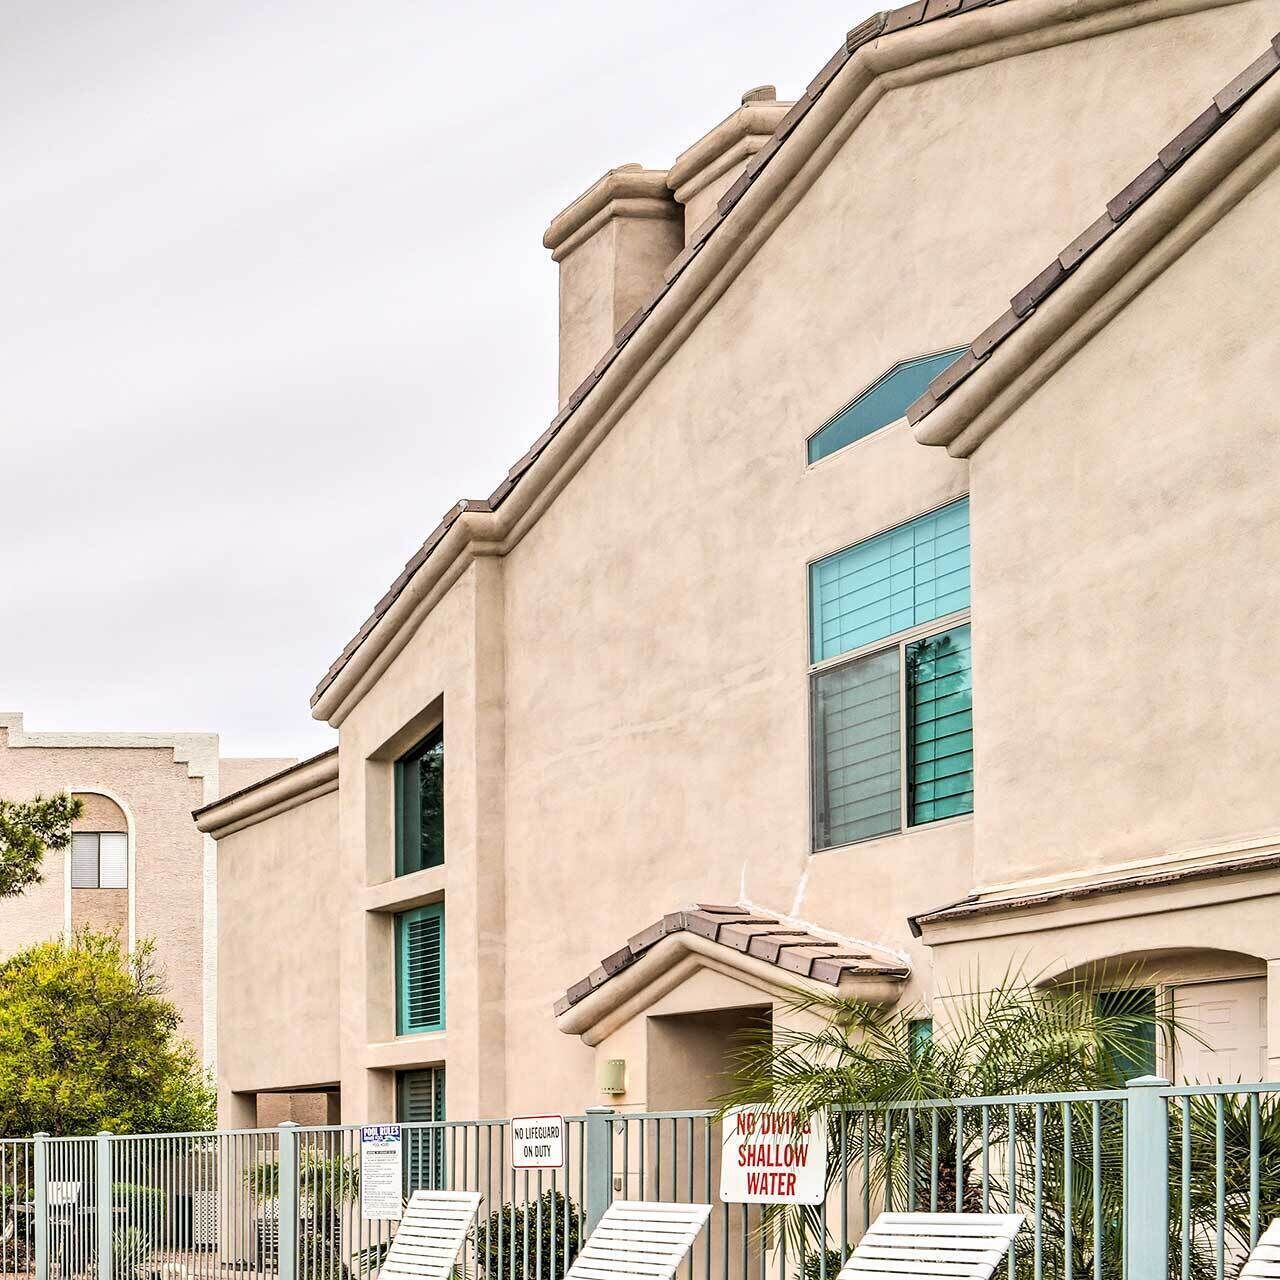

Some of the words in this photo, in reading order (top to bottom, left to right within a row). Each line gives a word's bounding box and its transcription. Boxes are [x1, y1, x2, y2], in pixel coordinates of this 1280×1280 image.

[364, 1128, 378, 1137] POOL
[379, 1127, 399, 1136] RULES
[515, 1128, 523, 1139] NO
[525, 1126, 559, 1139] LIFEGUARD
[737, 1113, 756, 1135] NO
[524, 1145, 532, 1157] ON
[534, 1145, 551, 1157] DUTY
[738, 1144, 808, 1167] SHALLOW
[747, 1172, 797, 1195] WATER
